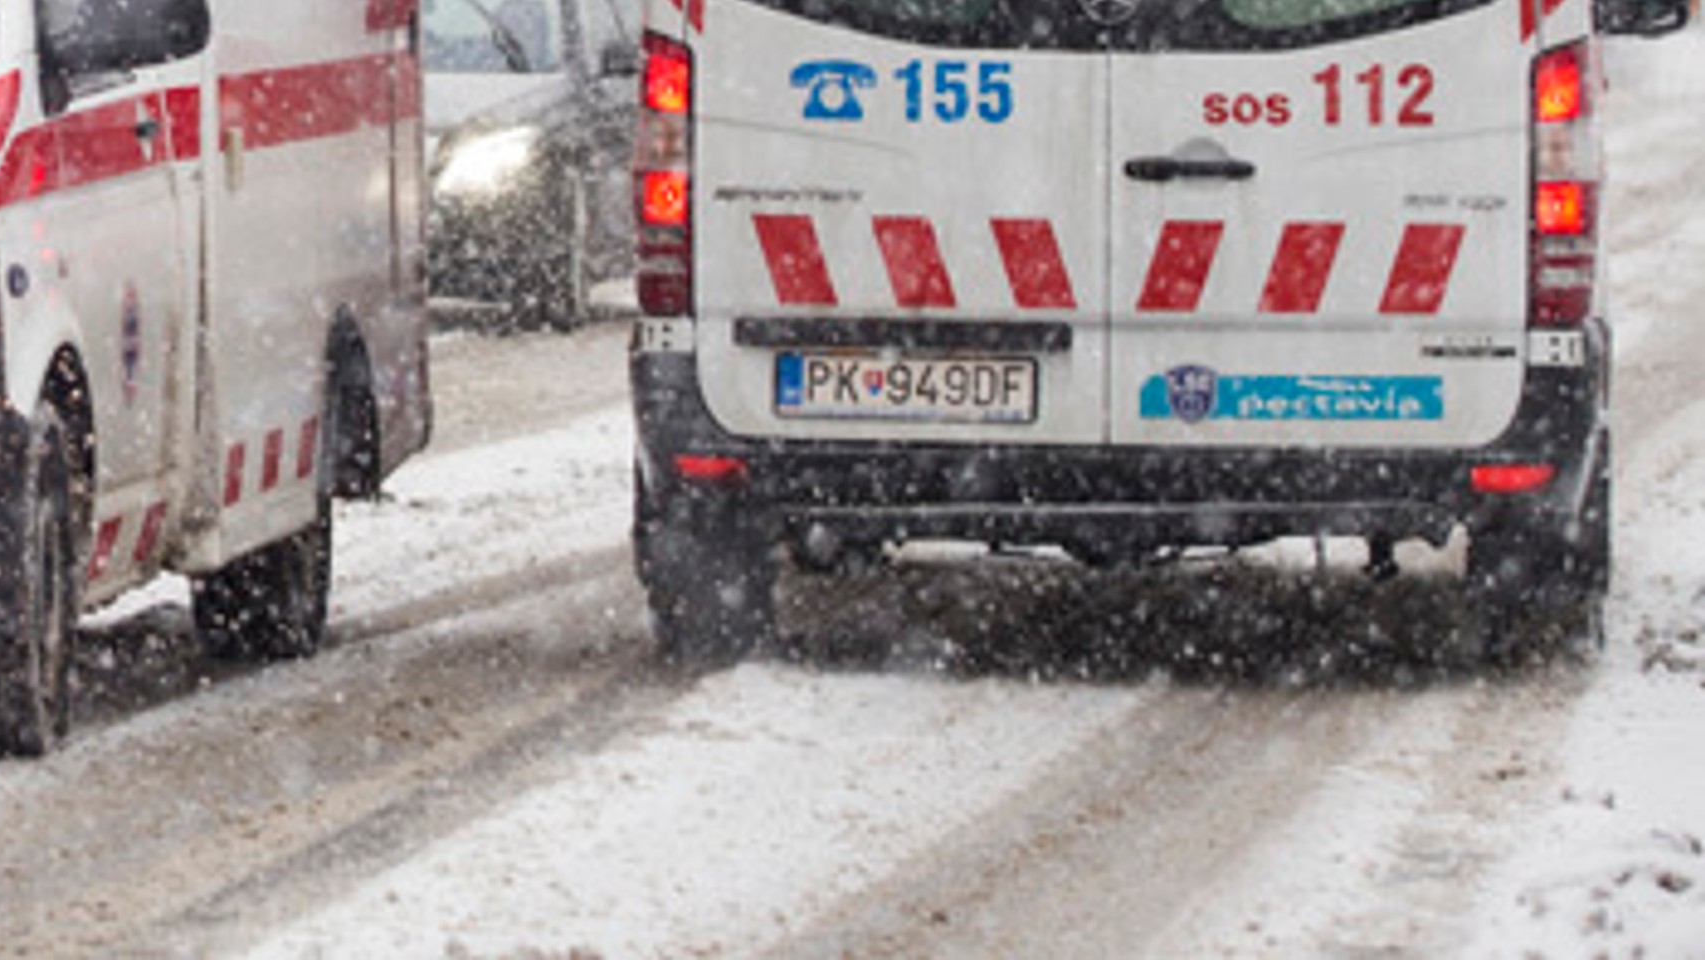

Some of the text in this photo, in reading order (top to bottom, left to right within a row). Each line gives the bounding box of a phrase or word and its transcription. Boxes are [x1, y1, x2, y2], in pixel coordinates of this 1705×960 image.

[894, 60, 1014, 123] 155
[1201, 63, 1435, 127] sos 112
